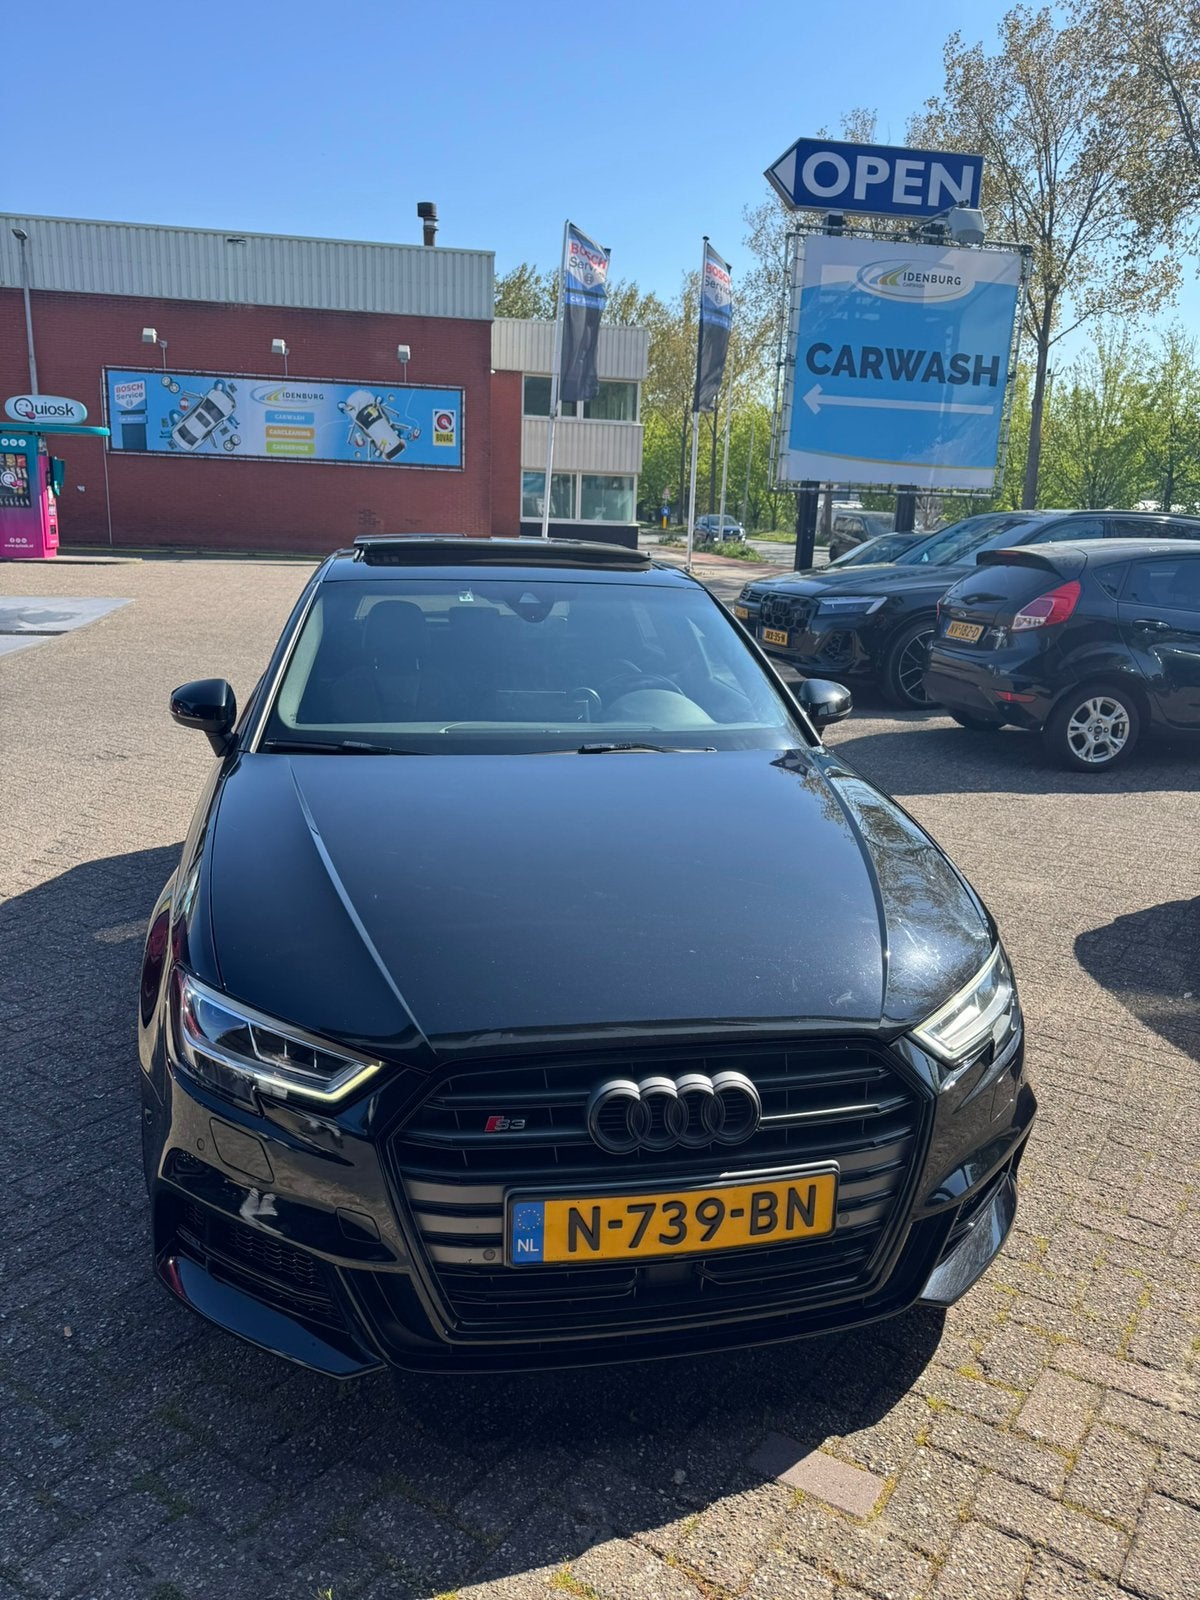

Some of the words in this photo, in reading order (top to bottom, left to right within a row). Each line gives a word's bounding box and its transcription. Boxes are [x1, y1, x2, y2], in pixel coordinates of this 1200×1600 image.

[802, 151, 975, 207] OPEN
[571, 242, 607, 270] BOSCH
[903, 271, 962, 286] IDENBURG
[806, 342, 1000, 388] CARWASH
[115, 382, 144, 394] BOSCH
[116, 391, 144, 401] Service
[282, 391, 325, 401] IDENBURG
[14, 398, 75, 419] Quiosk
[495, 1115, 527, 1130] S3
[567, 1184, 817, 1253] N-739-BN
[517, 1238, 539, 1252] NL
